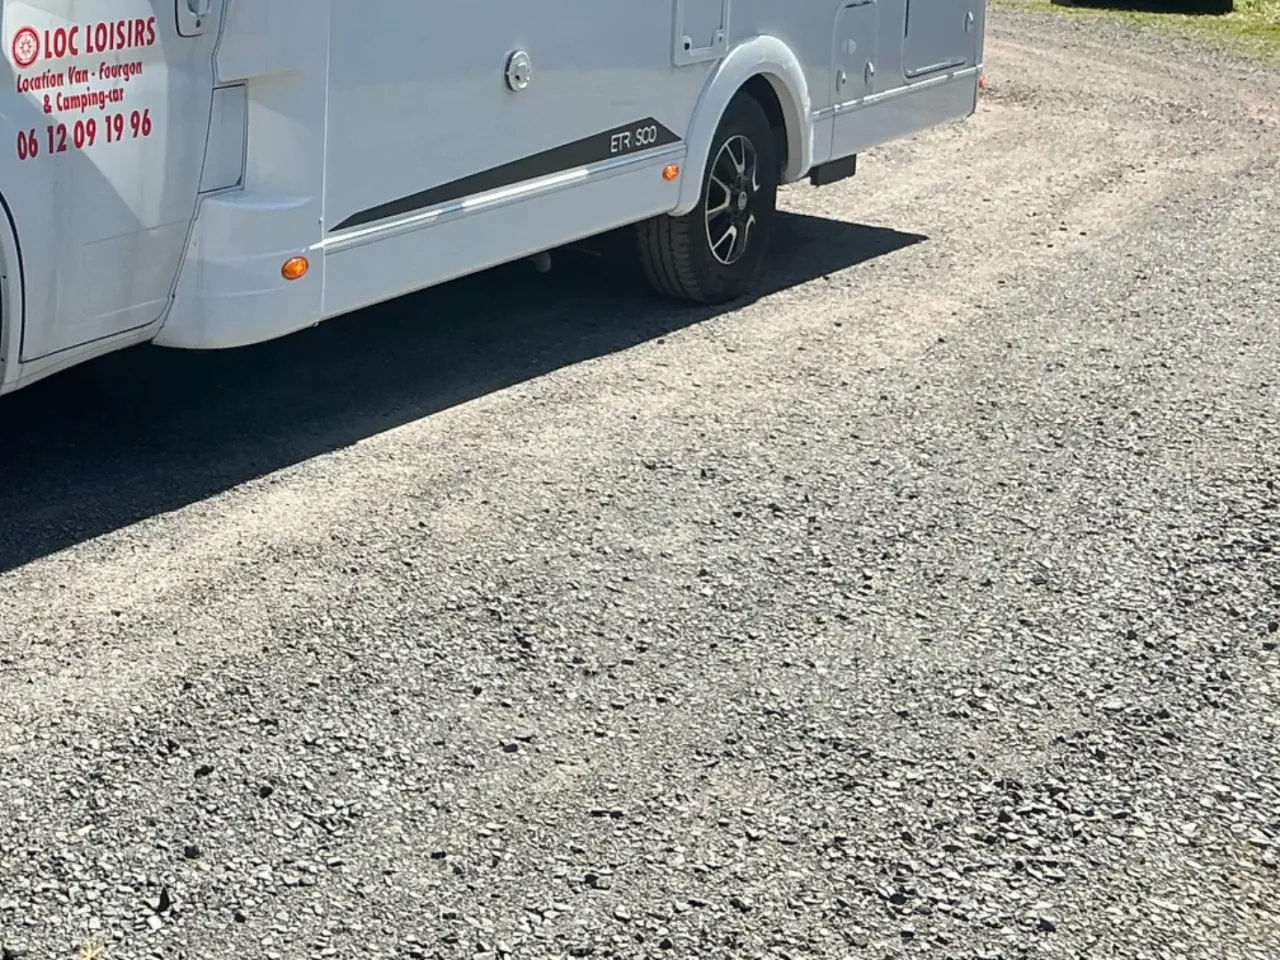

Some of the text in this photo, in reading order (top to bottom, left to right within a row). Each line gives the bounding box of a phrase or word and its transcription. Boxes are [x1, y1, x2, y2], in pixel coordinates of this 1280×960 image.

[44, 16, 156, 59] LOC LOISIRS
[16, 69, 64, 93] Location
[68, 66, 89, 84] Van
[99, 61, 143, 82] Fourgon
[43, 87, 124, 114] & Camping-car
[17, 108, 152, 161] 06 12 09 19 96
[610, 125, 657, 153] ETRSCO
